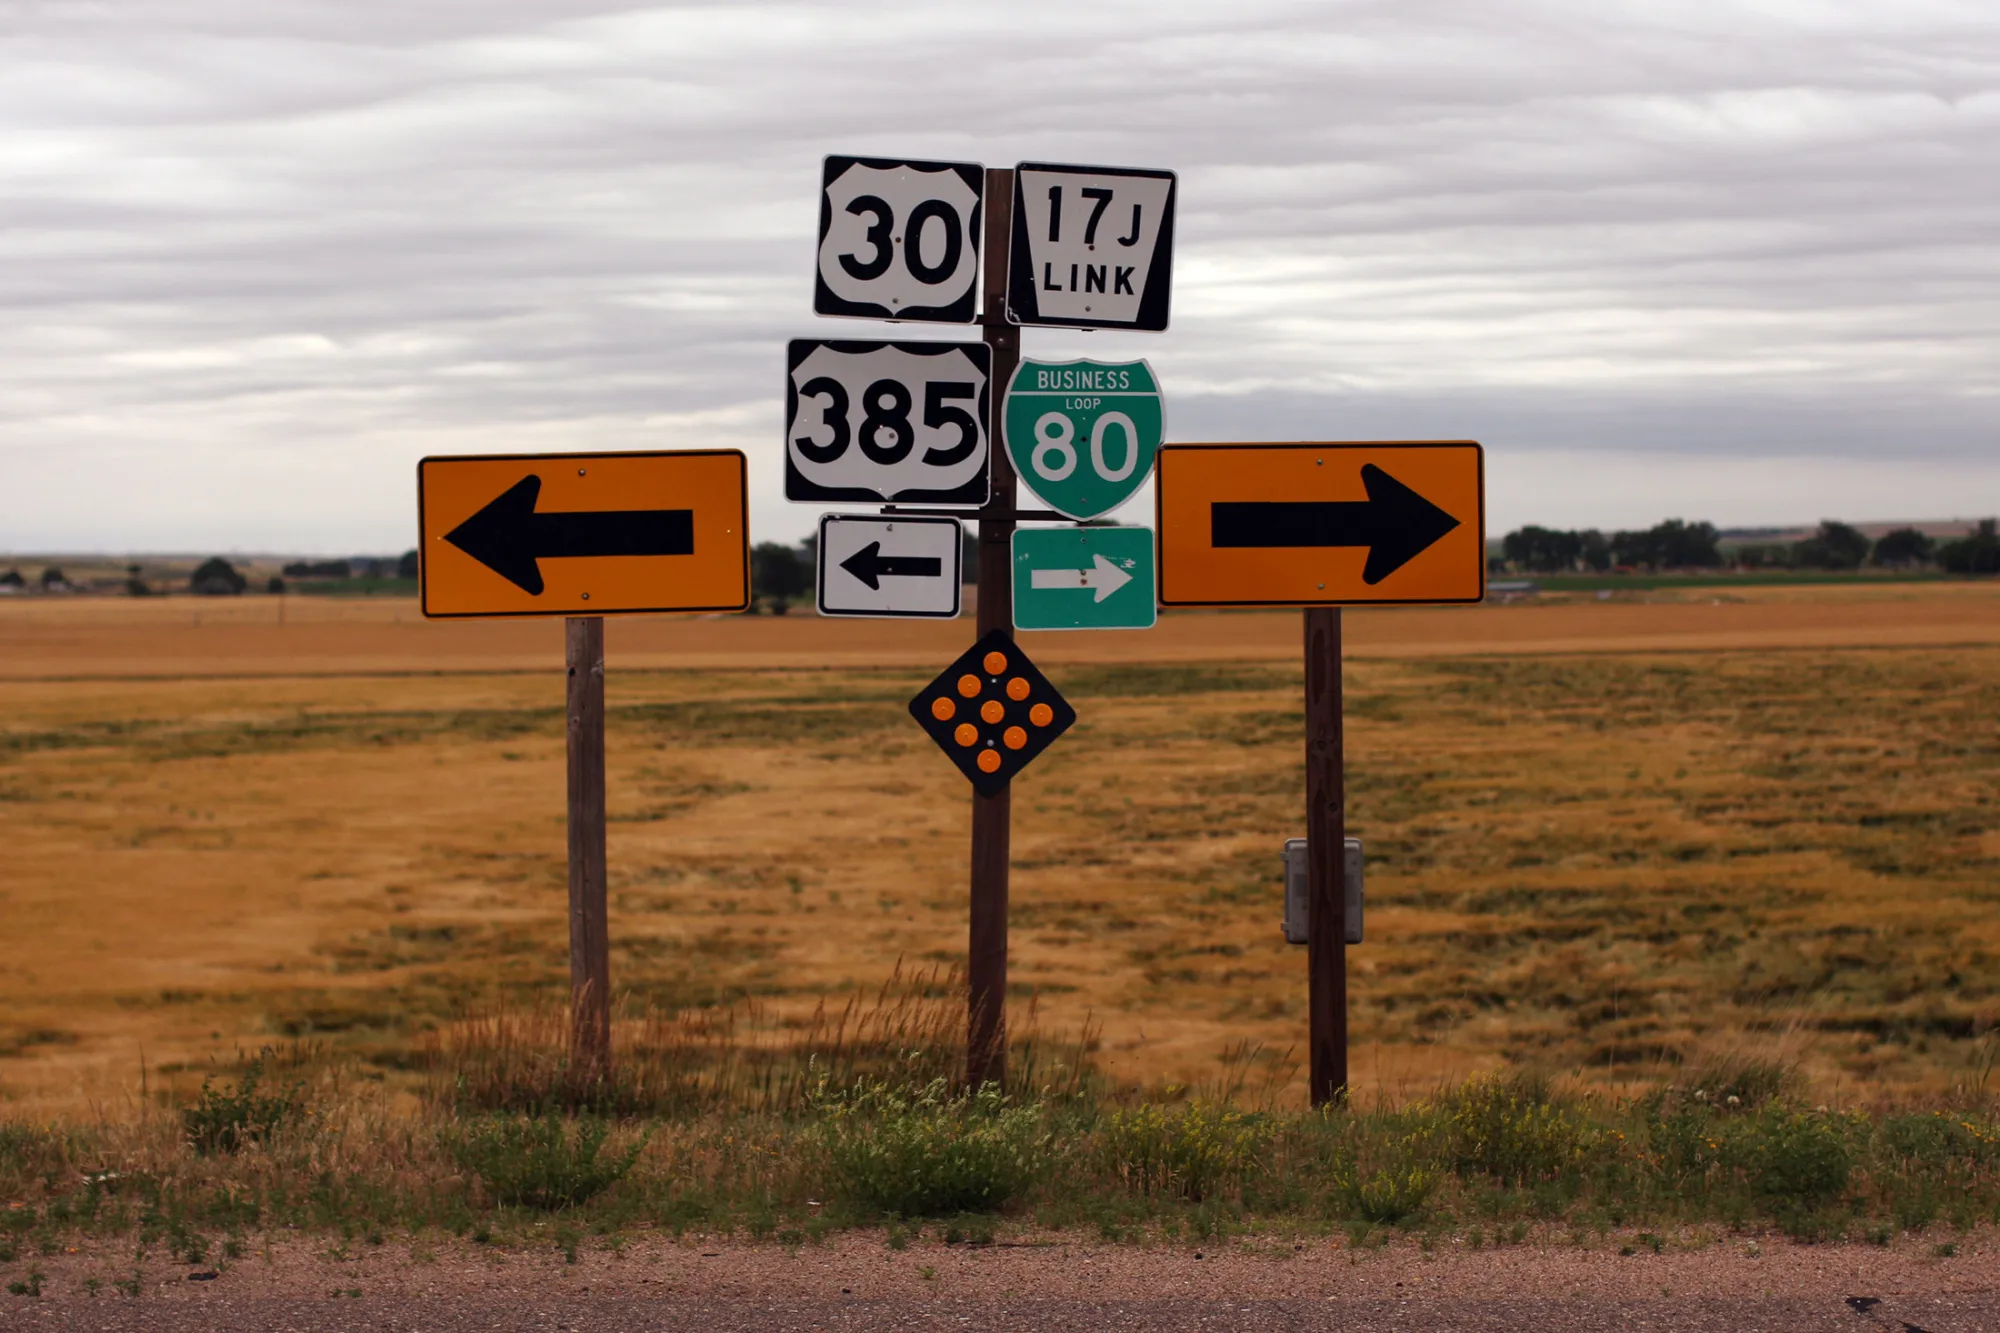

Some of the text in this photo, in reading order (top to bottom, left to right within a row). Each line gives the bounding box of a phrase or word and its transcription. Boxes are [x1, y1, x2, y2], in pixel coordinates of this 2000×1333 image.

[838, 195, 961, 284] 30
[1044, 262, 1135, 295] LINK
[1037, 370, 1130, 389] BUSINESS
[1065, 398, 1101, 410] LOOP
[795, 376, 979, 467] 385
[1031, 411, 1139, 483] 80
